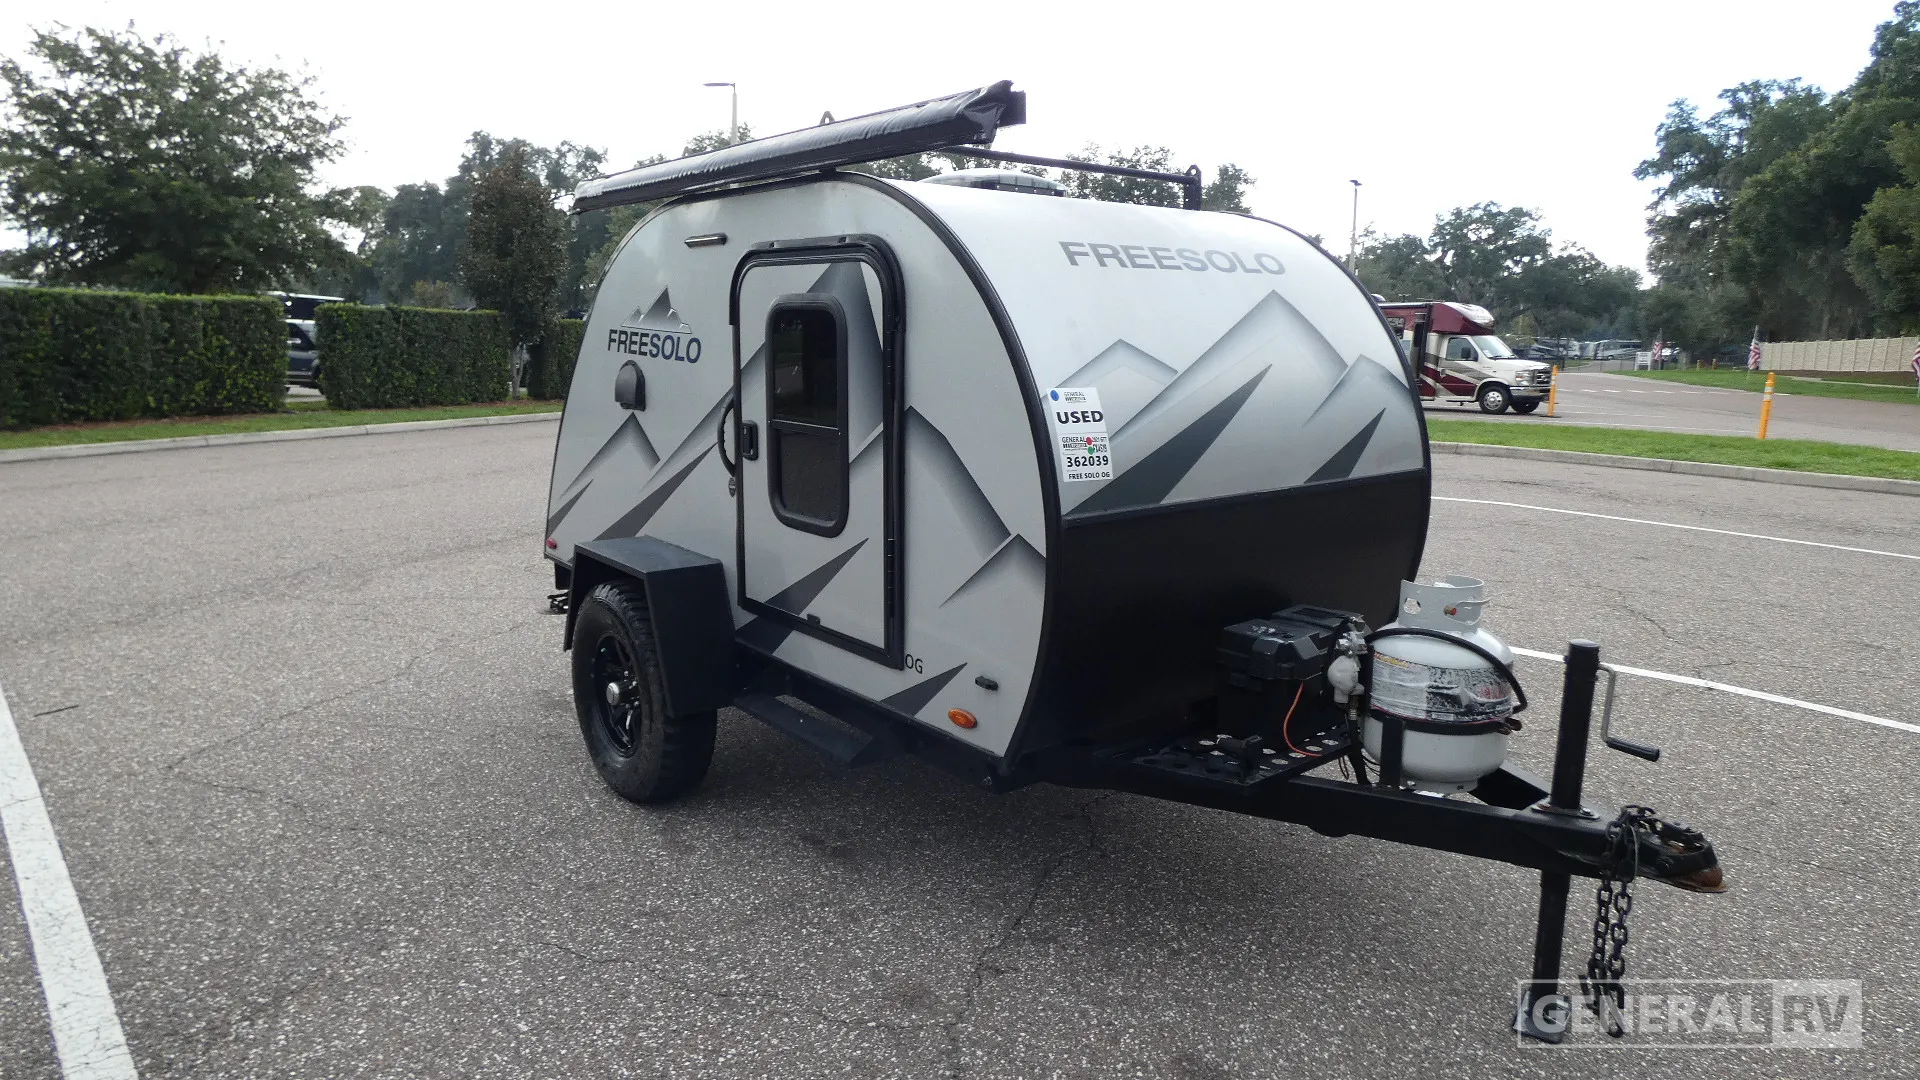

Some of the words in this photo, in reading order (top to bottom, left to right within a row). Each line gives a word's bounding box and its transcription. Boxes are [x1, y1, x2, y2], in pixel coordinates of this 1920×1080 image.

[1058, 241, 1286, 275] FREESOLO
[607, 329, 702, 363] FREESOLO
[1056, 410, 1104, 424] USED
[1066, 455, 1109, 468] 362039
[905, 654, 923, 674] OG
